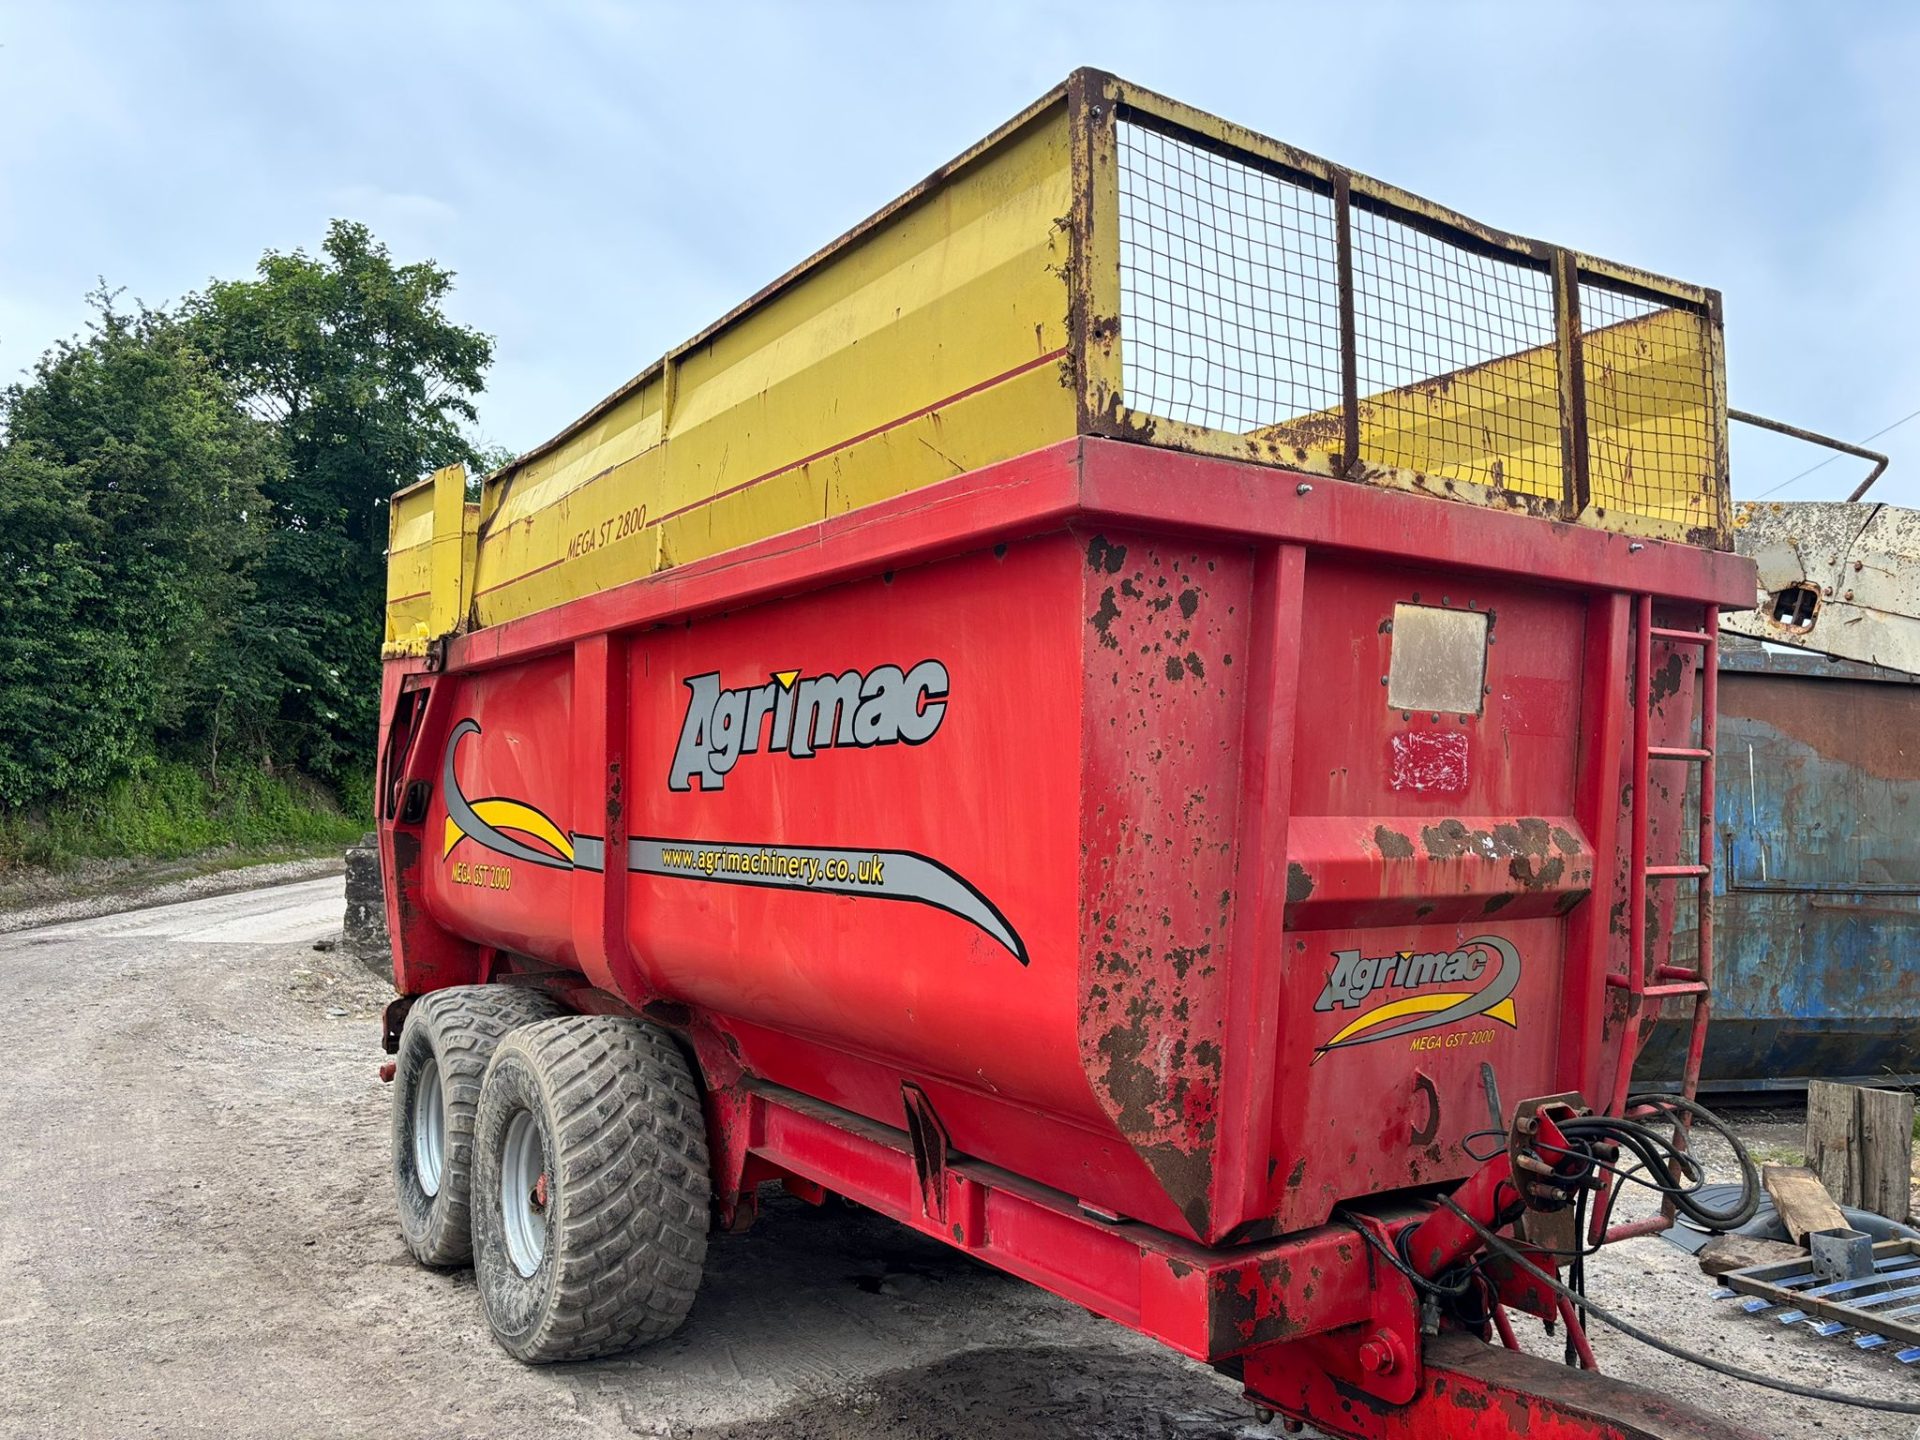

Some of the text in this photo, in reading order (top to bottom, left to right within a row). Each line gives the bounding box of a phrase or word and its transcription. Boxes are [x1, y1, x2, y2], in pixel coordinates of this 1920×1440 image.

[566, 503, 647, 561] MEGA ST 2800
[668, 658, 950, 792] Agrimac
[452, 862, 512, 891] MEGA GST 2000
[661, 847, 884, 885] www.agrimachinery.co.uk
[1313, 949, 1488, 1012] Agrimac
[1409, 1029, 1496, 1052] MEGA GST 2000
